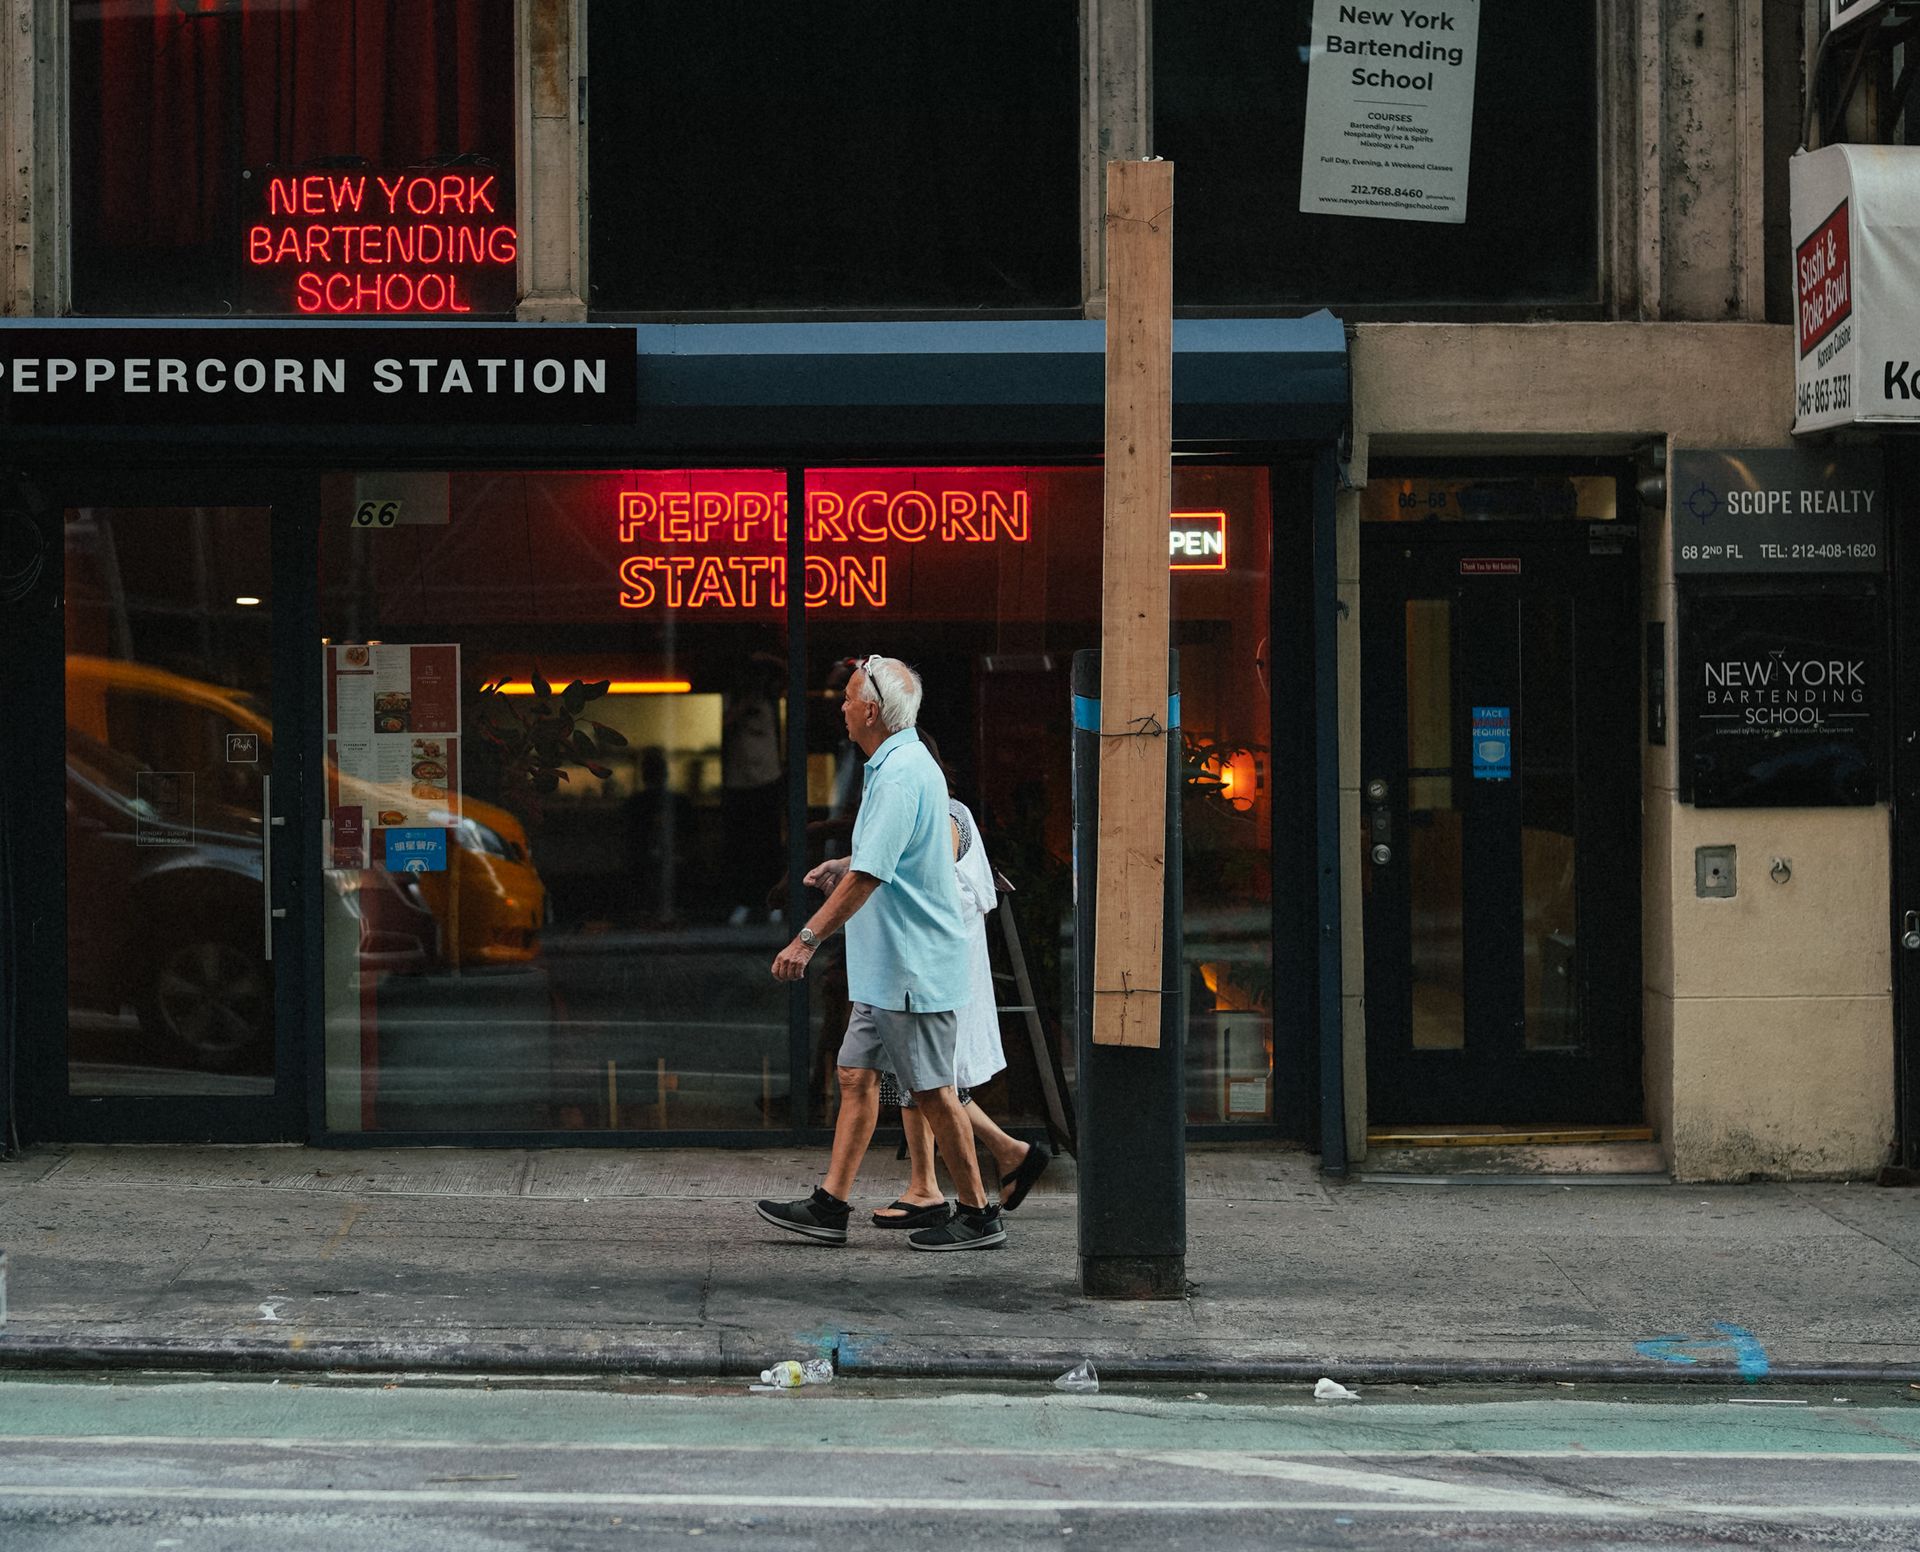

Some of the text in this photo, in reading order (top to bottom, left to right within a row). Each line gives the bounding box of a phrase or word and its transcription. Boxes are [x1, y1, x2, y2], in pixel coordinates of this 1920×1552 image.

[1339, 5, 1455, 31] New York
[1326, 35, 1463, 66] Bartending
[1351, 67, 1433, 91] School
[1350, 122, 1390, 132] Bartending
[1396, 125, 1429, 134] Mixology
[1367, 112, 1413, 123] COURSES
[1344, 130, 1382, 140] Hospitality
[1384, 133, 1403, 141] Wine
[1411, 135, 1434, 144] Spirits
[1360, 140, 1392, 150] Mixology
[1320, 156, 1334, 164] Full
[1391, 161, 1426, 171] Weekend
[1427, 163, 1453, 172] Classes
[270, 175, 495, 214] NEW YORK
[1319, 195, 1450, 212] www.newyorkbartendingschool.com
[1350, 185, 1423, 199] 212.768.8460
[250, 225, 518, 265] BARTENDING
[1800, 229, 1837, 296] Sushi &
[297, 273, 471, 313] SCHOOL
[1802, 260, 1848, 341] Poke Bowl
[1817, 324, 1852, 370] Korean Cuisine
[0, 358, 606, 394] EPPERCORN STATION
[1398, 492, 1446, 508] 66-68
[1727, 490, 1875, 515] SCOPE REALTY
[357, 502, 398, 525] 66
[1169, 531, 1222, 555] PEN
[1682, 544, 1876, 560] 68 2ND FL TEL: 212-408-1620
[1462, 562, 1476, 572] Thank
[619, 555, 887, 608] STATION
[1705, 661, 1865, 687] NEW YORK
[1707, 690, 1863, 704] BARTENDING
[1481, 710, 1503, 718] FACE
[1745, 707, 1825, 724] SCHOOL
